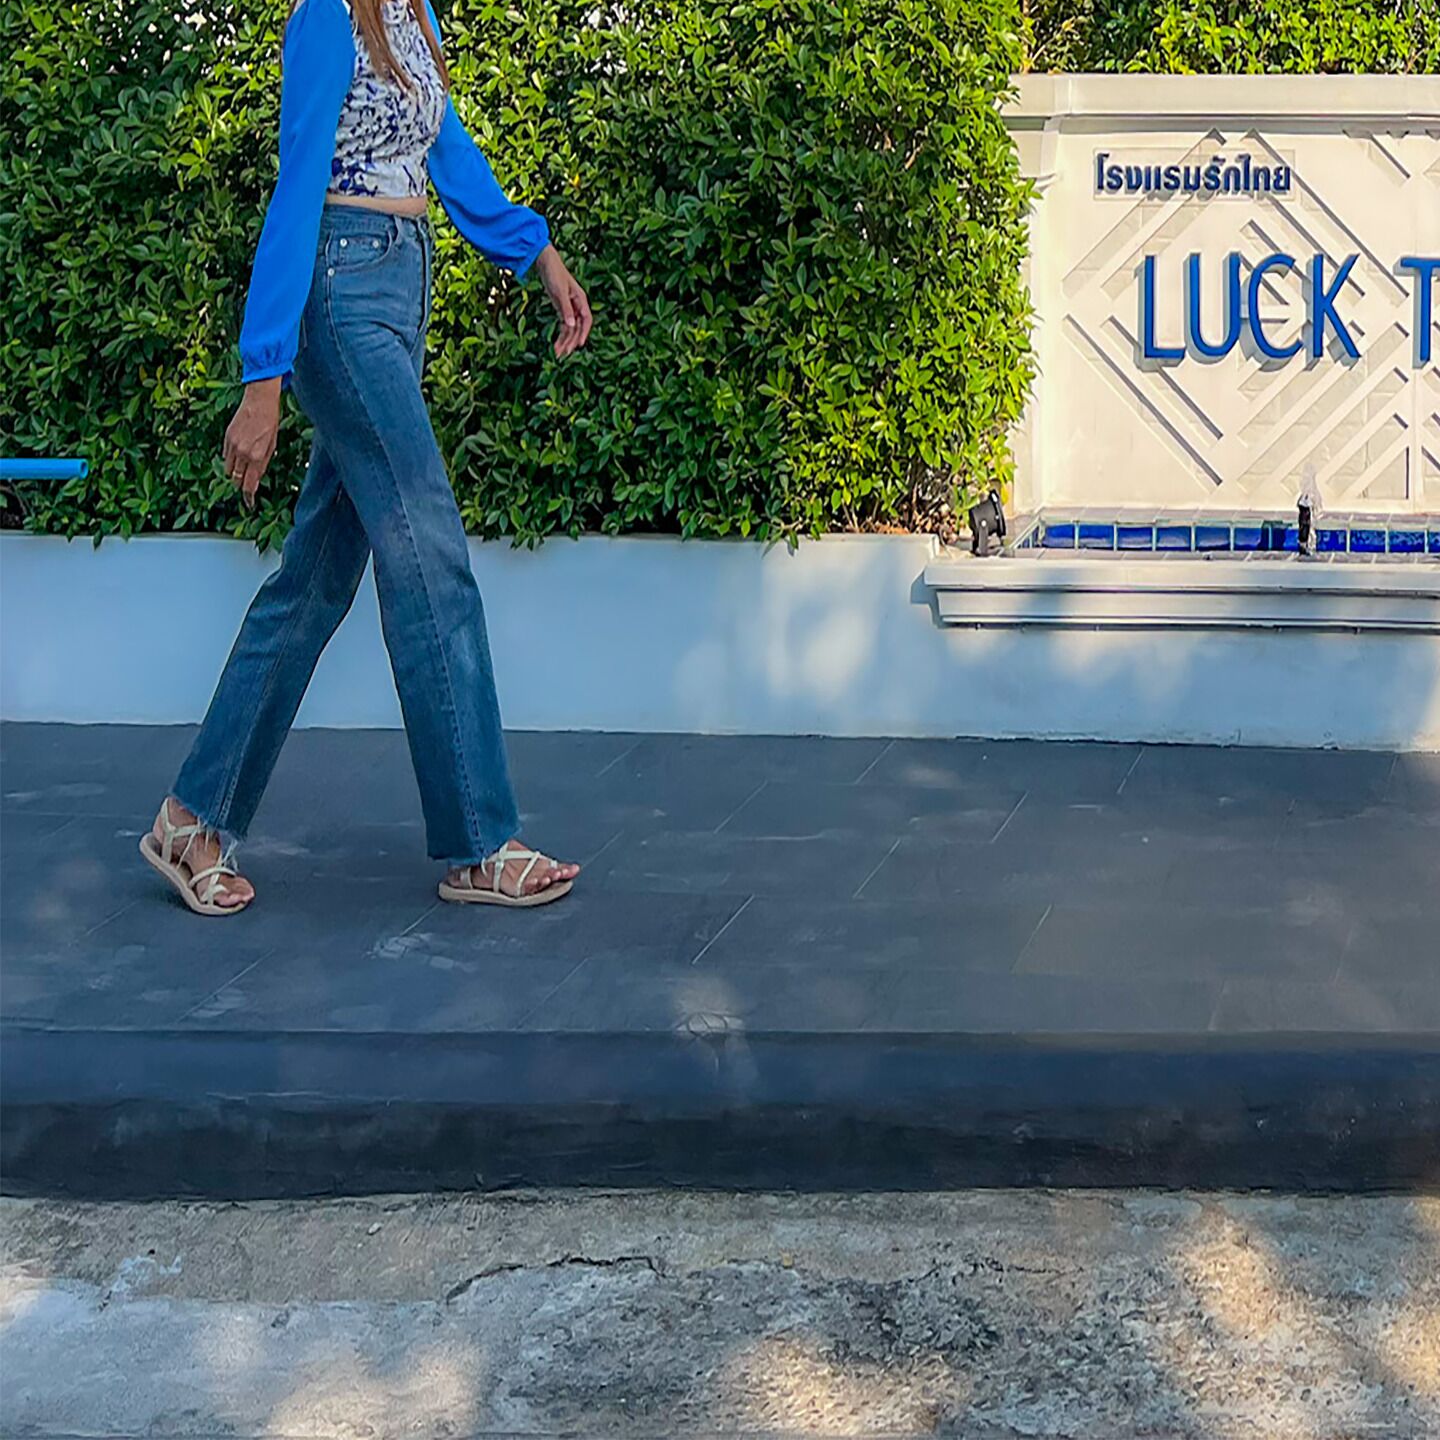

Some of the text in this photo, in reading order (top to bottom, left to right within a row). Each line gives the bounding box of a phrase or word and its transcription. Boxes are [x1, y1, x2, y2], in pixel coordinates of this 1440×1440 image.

[1096, 152, 1291, 192] โรงแรมรักไทย
[1143, 251, 1362, 359] LUCK
